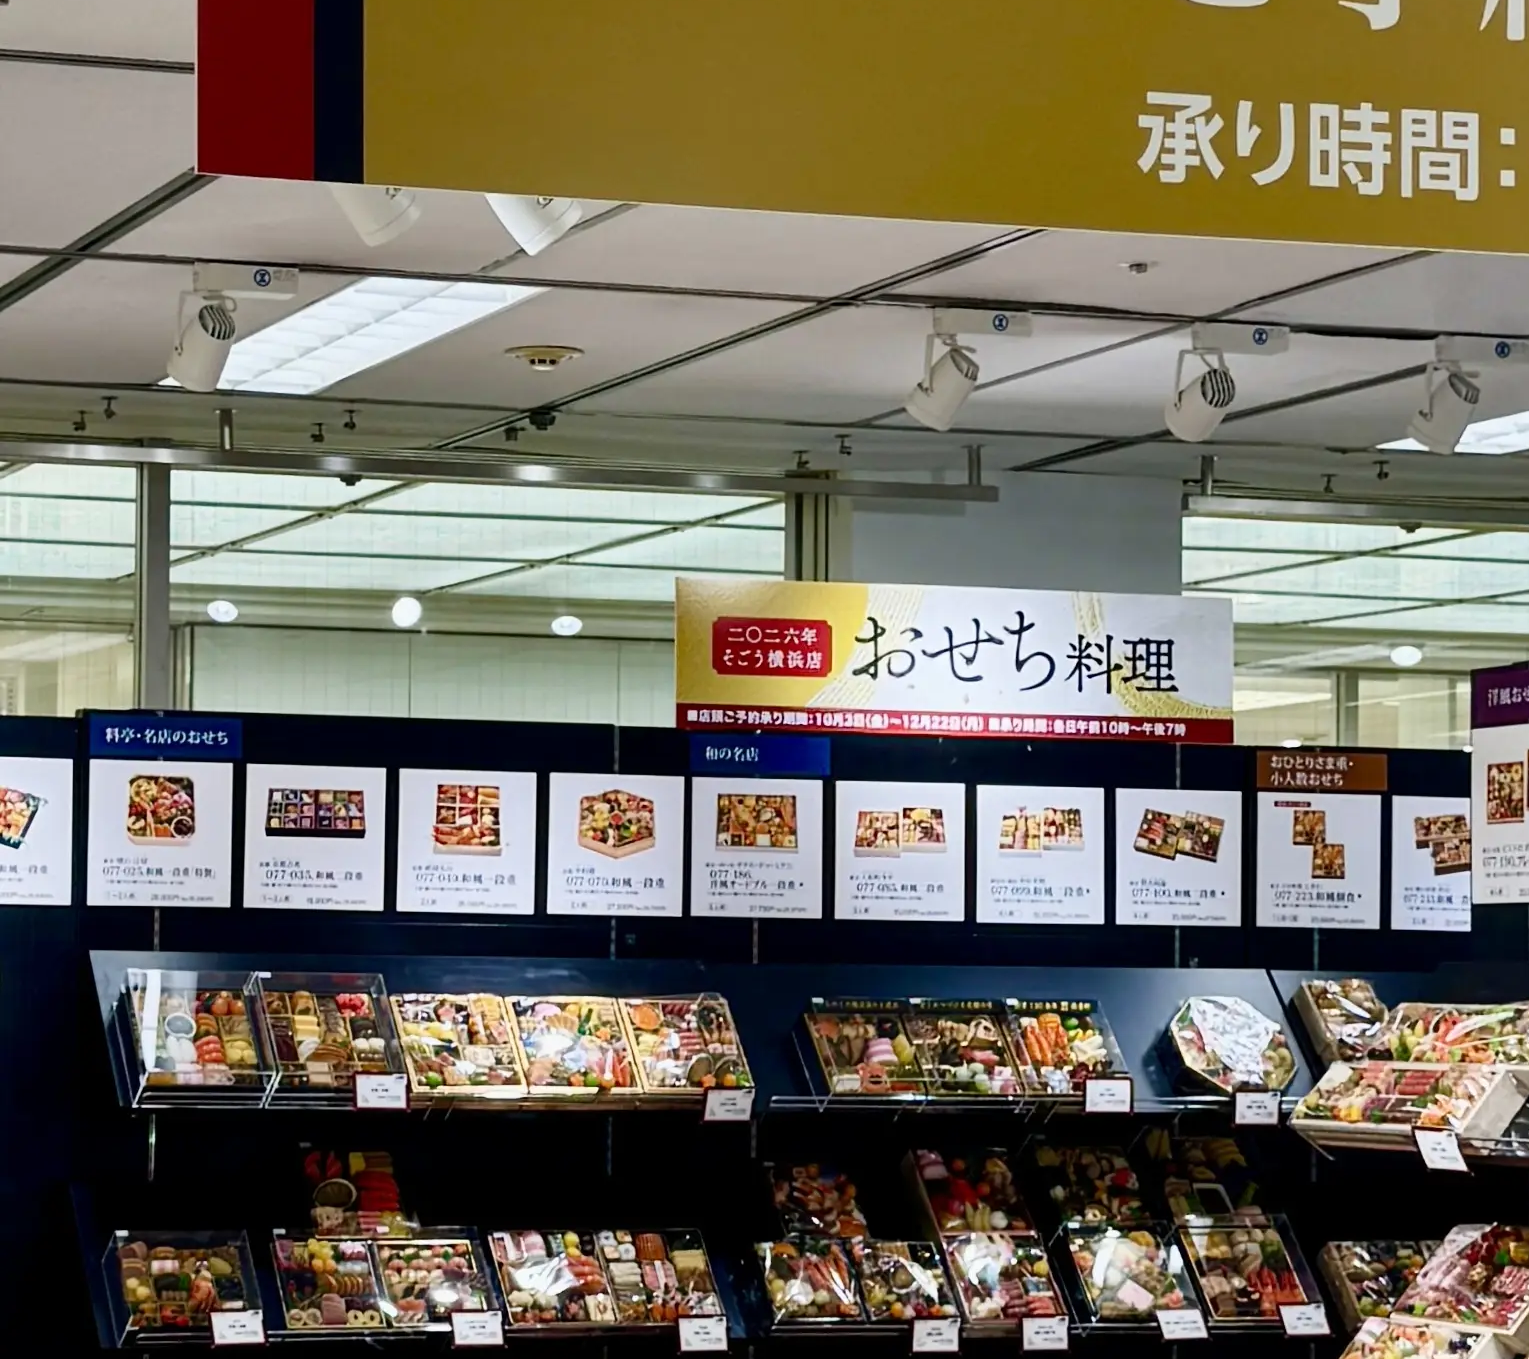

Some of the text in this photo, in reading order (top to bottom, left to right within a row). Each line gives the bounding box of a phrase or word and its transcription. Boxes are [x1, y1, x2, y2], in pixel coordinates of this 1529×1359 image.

[722, 649, 823, 671] そごう横浜店
[852, 610, 1181, 694] おせち料理
[104, 726, 229, 746] 料亭・名店のおせち
[706, 746, 760, 762] 和の名店
